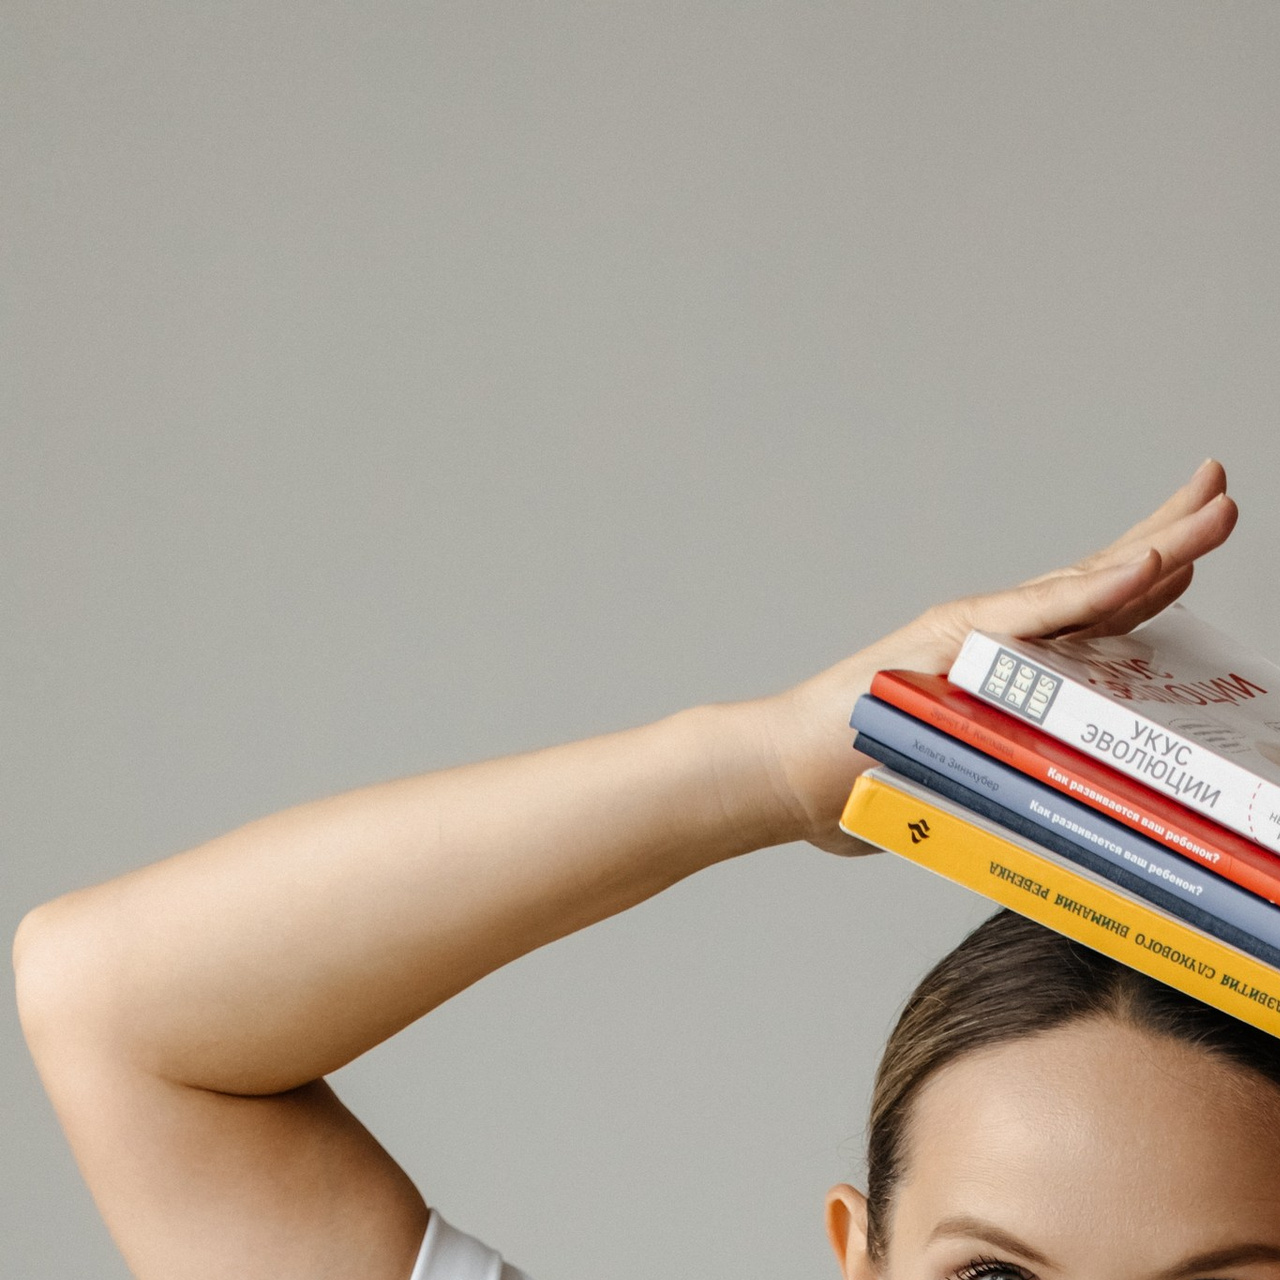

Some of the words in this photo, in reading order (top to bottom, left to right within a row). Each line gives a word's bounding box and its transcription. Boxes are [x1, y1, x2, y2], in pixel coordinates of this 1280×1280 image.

[986, 655, 1015, 696] RES
[1005, 666, 1037, 707] PEC
[1026, 677, 1055, 716] TUS
[912, 739, 946, 764] Хельга
[947, 757, 1000, 792] Зиннхубер
[1080, 723, 1221, 808] ЭВОЛЮЦИИ
[1131, 720, 1192, 766] УКУС
[1047, 767, 1069, 785] Как
[1070, 779, 1140, 822] развивается
[1141, 816, 1165, 834] ваш
[1165, 827, 1221, 865] ребенок?
[1029, 799, 1051, 819] Как
[1051, 811, 1122, 856] развивается
[1123, 849, 1147, 868] ваш
[1148, 861, 1204, 897] ребенок?
[989, 861, 1050, 900] РЕБЕНКА
[1053, 893, 1131, 938] ВНИМАНИЯ
[1134, 933, 1216, 979] СЛУХОВОГО
